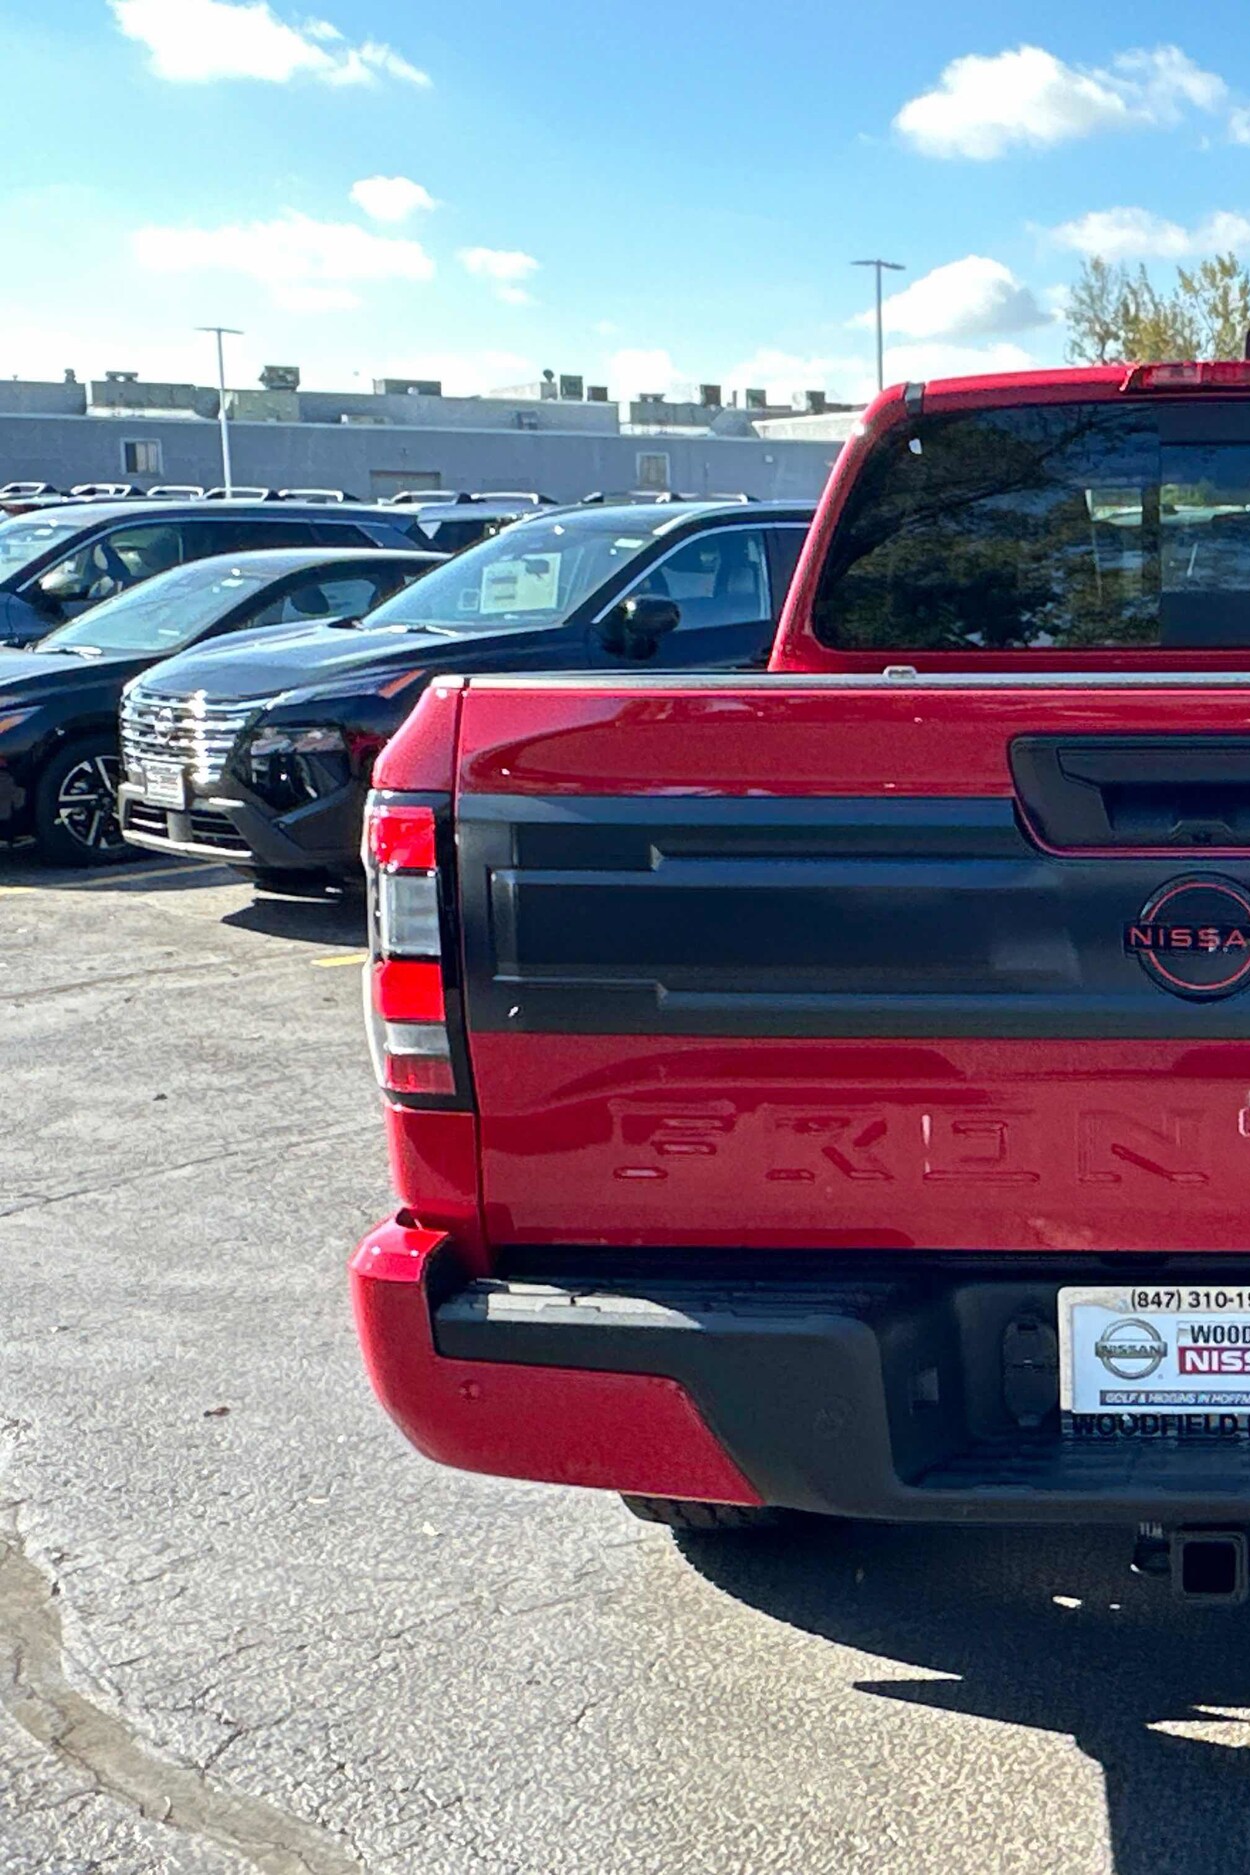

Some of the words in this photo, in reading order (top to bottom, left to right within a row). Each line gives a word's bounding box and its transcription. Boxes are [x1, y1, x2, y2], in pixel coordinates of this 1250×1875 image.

[1131, 1288, 1182, 1312] (847)
[1101, 1344, 1161, 1357] NISSAN
[1105, 1392, 1138, 1404] GOLF
[1197, 1392, 1210, 1405] IN
[1072, 1413, 1239, 1437] WOODFIELD
